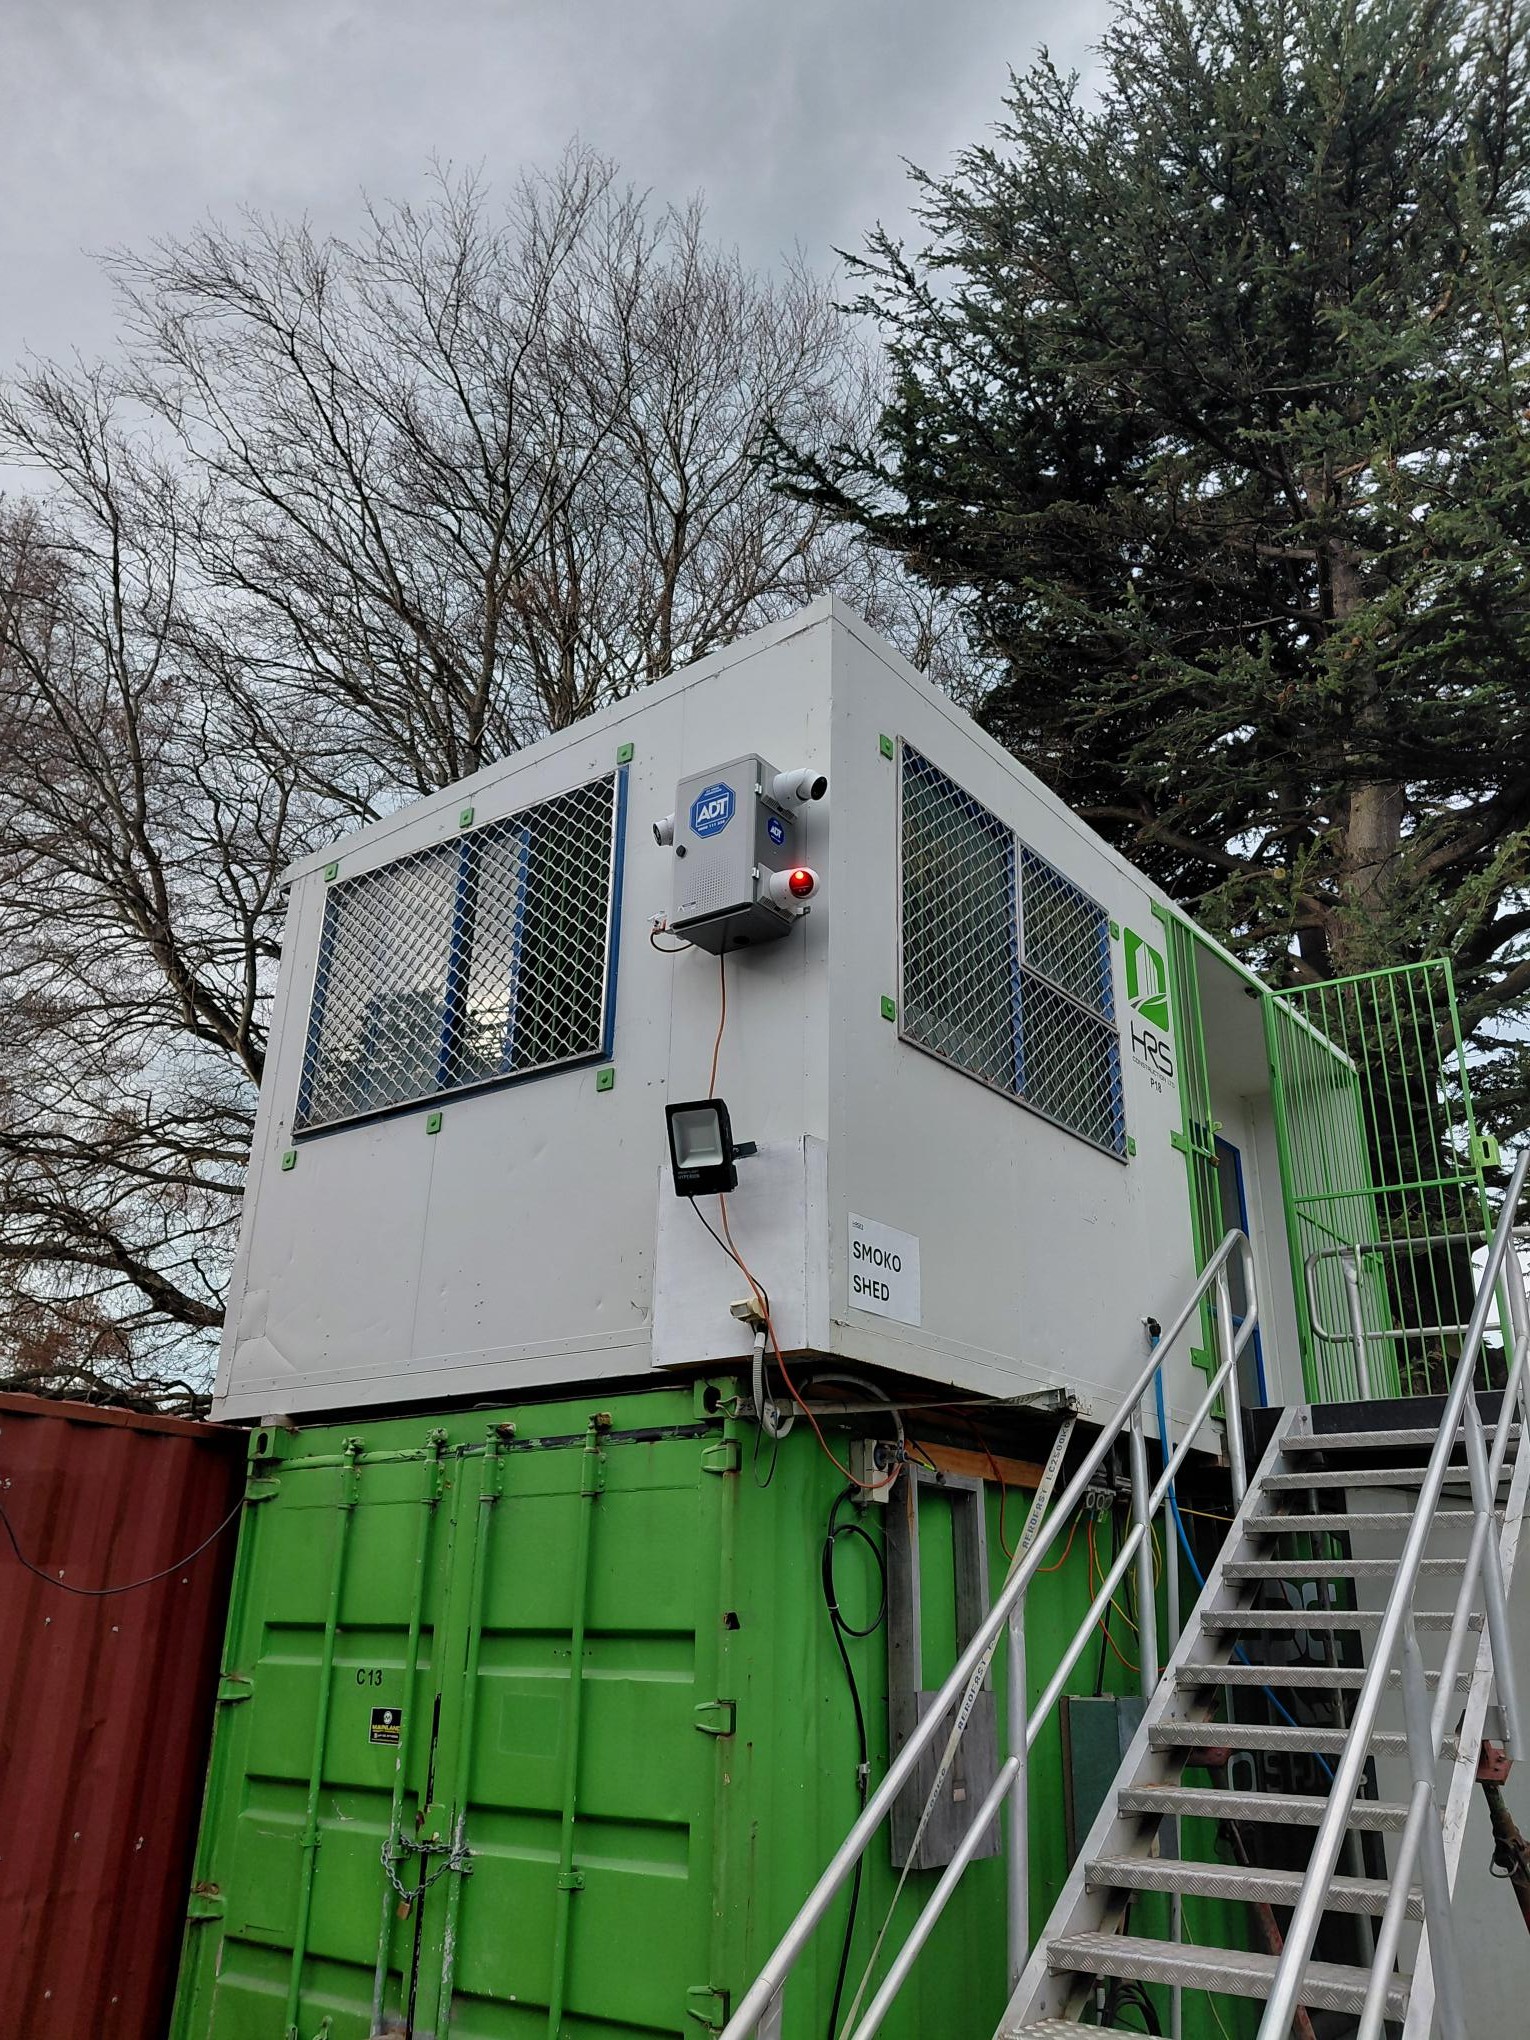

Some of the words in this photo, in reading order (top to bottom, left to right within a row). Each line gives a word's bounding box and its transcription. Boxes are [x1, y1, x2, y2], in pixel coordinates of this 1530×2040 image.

[697, 796, 729, 823] ADT
[770, 825, 782, 839] ADT
[1130, 1020, 1174, 1078] HRS
[853, 1240, 902, 1273] SMOKO
[853, 1274, 890, 1302] SHED
[356, 1668, 383, 1686] C13
